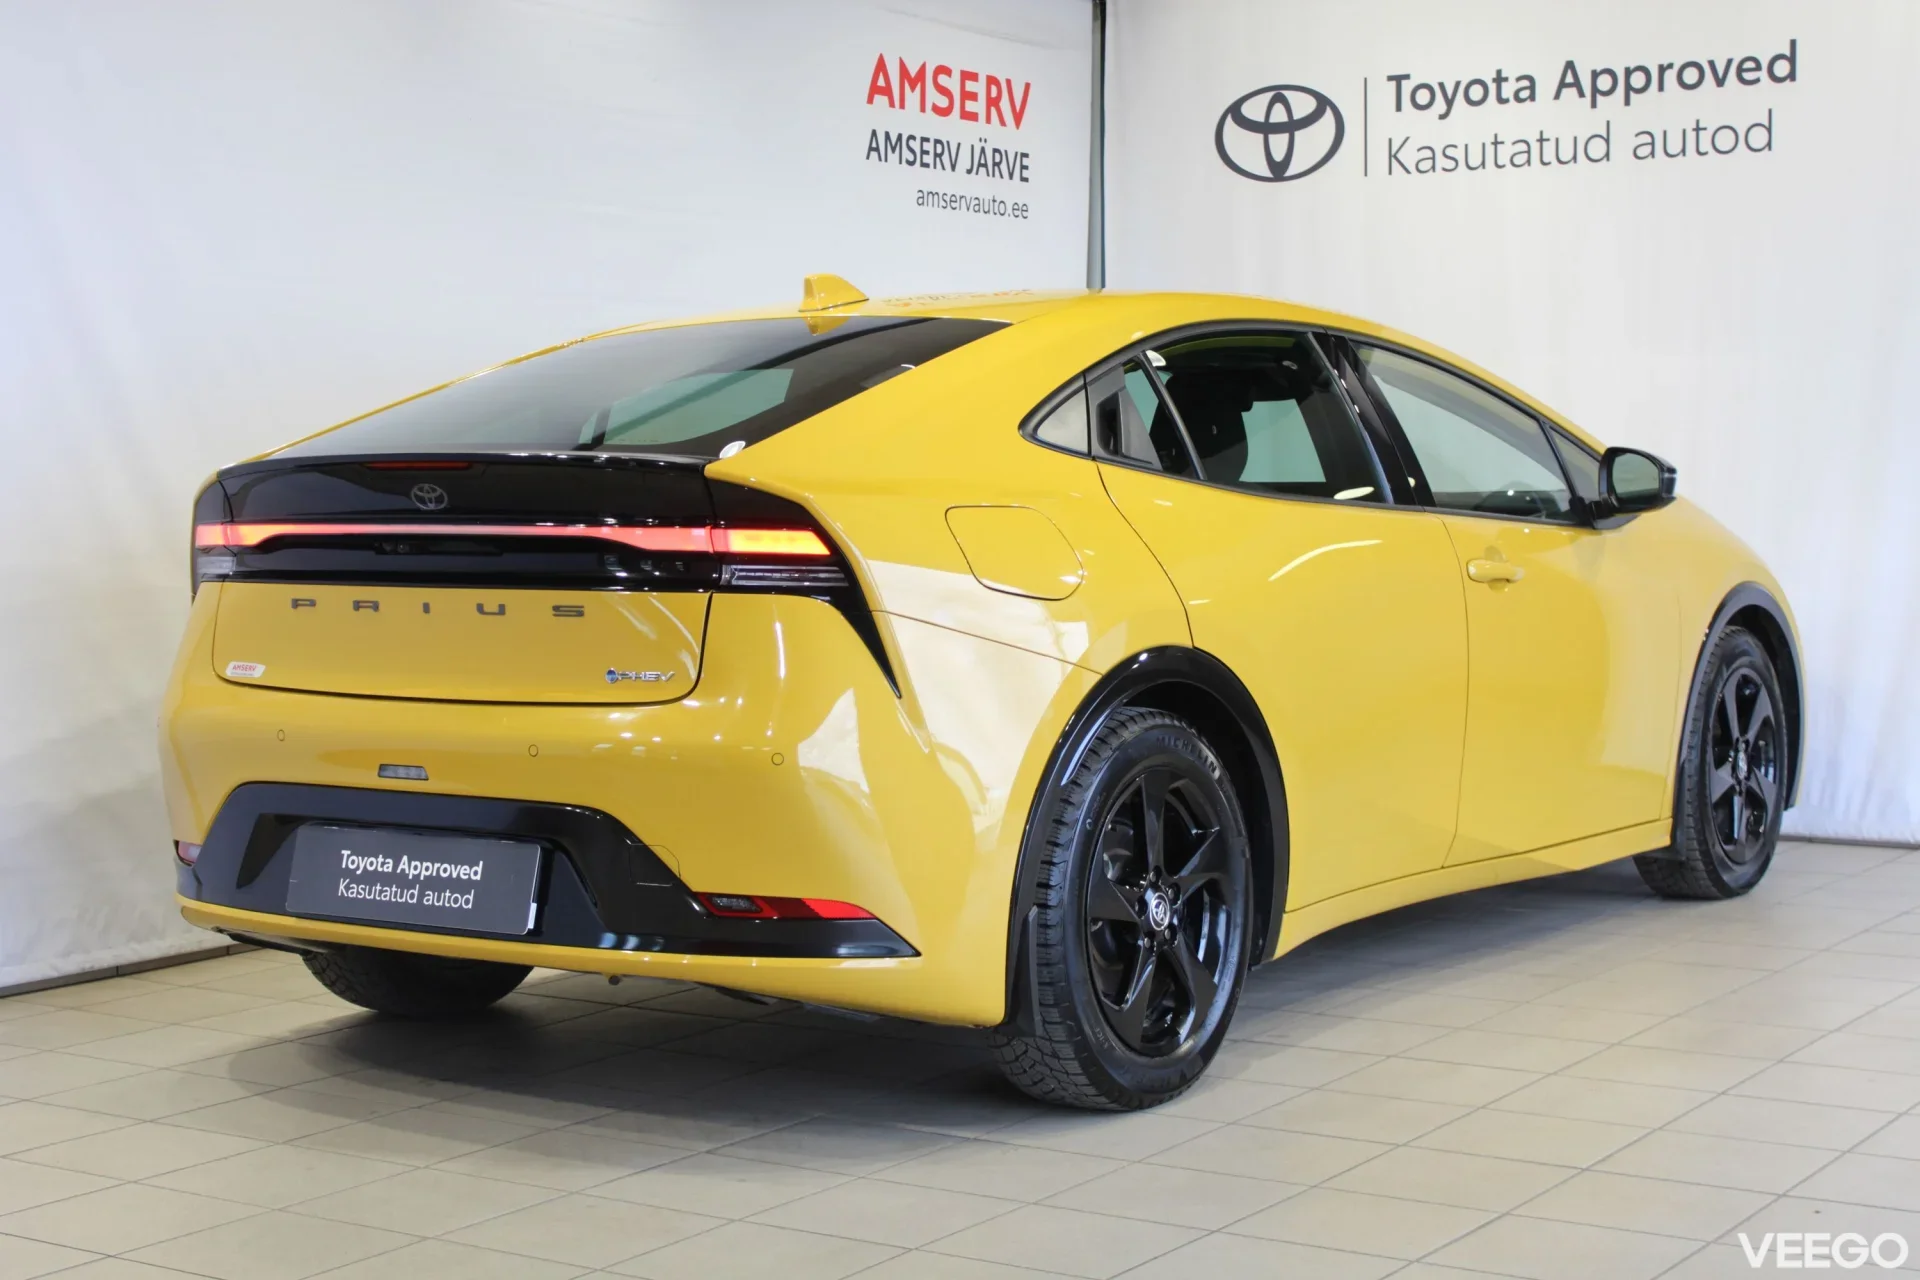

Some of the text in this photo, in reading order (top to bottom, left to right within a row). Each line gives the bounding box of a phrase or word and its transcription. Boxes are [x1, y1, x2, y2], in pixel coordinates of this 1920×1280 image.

[866, 53, 1031, 130] AMSERV
[1387, 39, 1798, 120] Toyota Approved
[866, 128, 1030, 183] AMSERV JÄRVE
[1387, 109, 1774, 176] Kasutatud autod
[916, 189, 1029, 220] amservauto.ee
[291, 597, 585, 618] PRIUS
[232, 664, 257, 672] AMSERV
[618, 671, 675, 682] PHEV
[340, 850, 484, 880] Toyota Approved
[338, 878, 475, 909] Kasutatud autod
